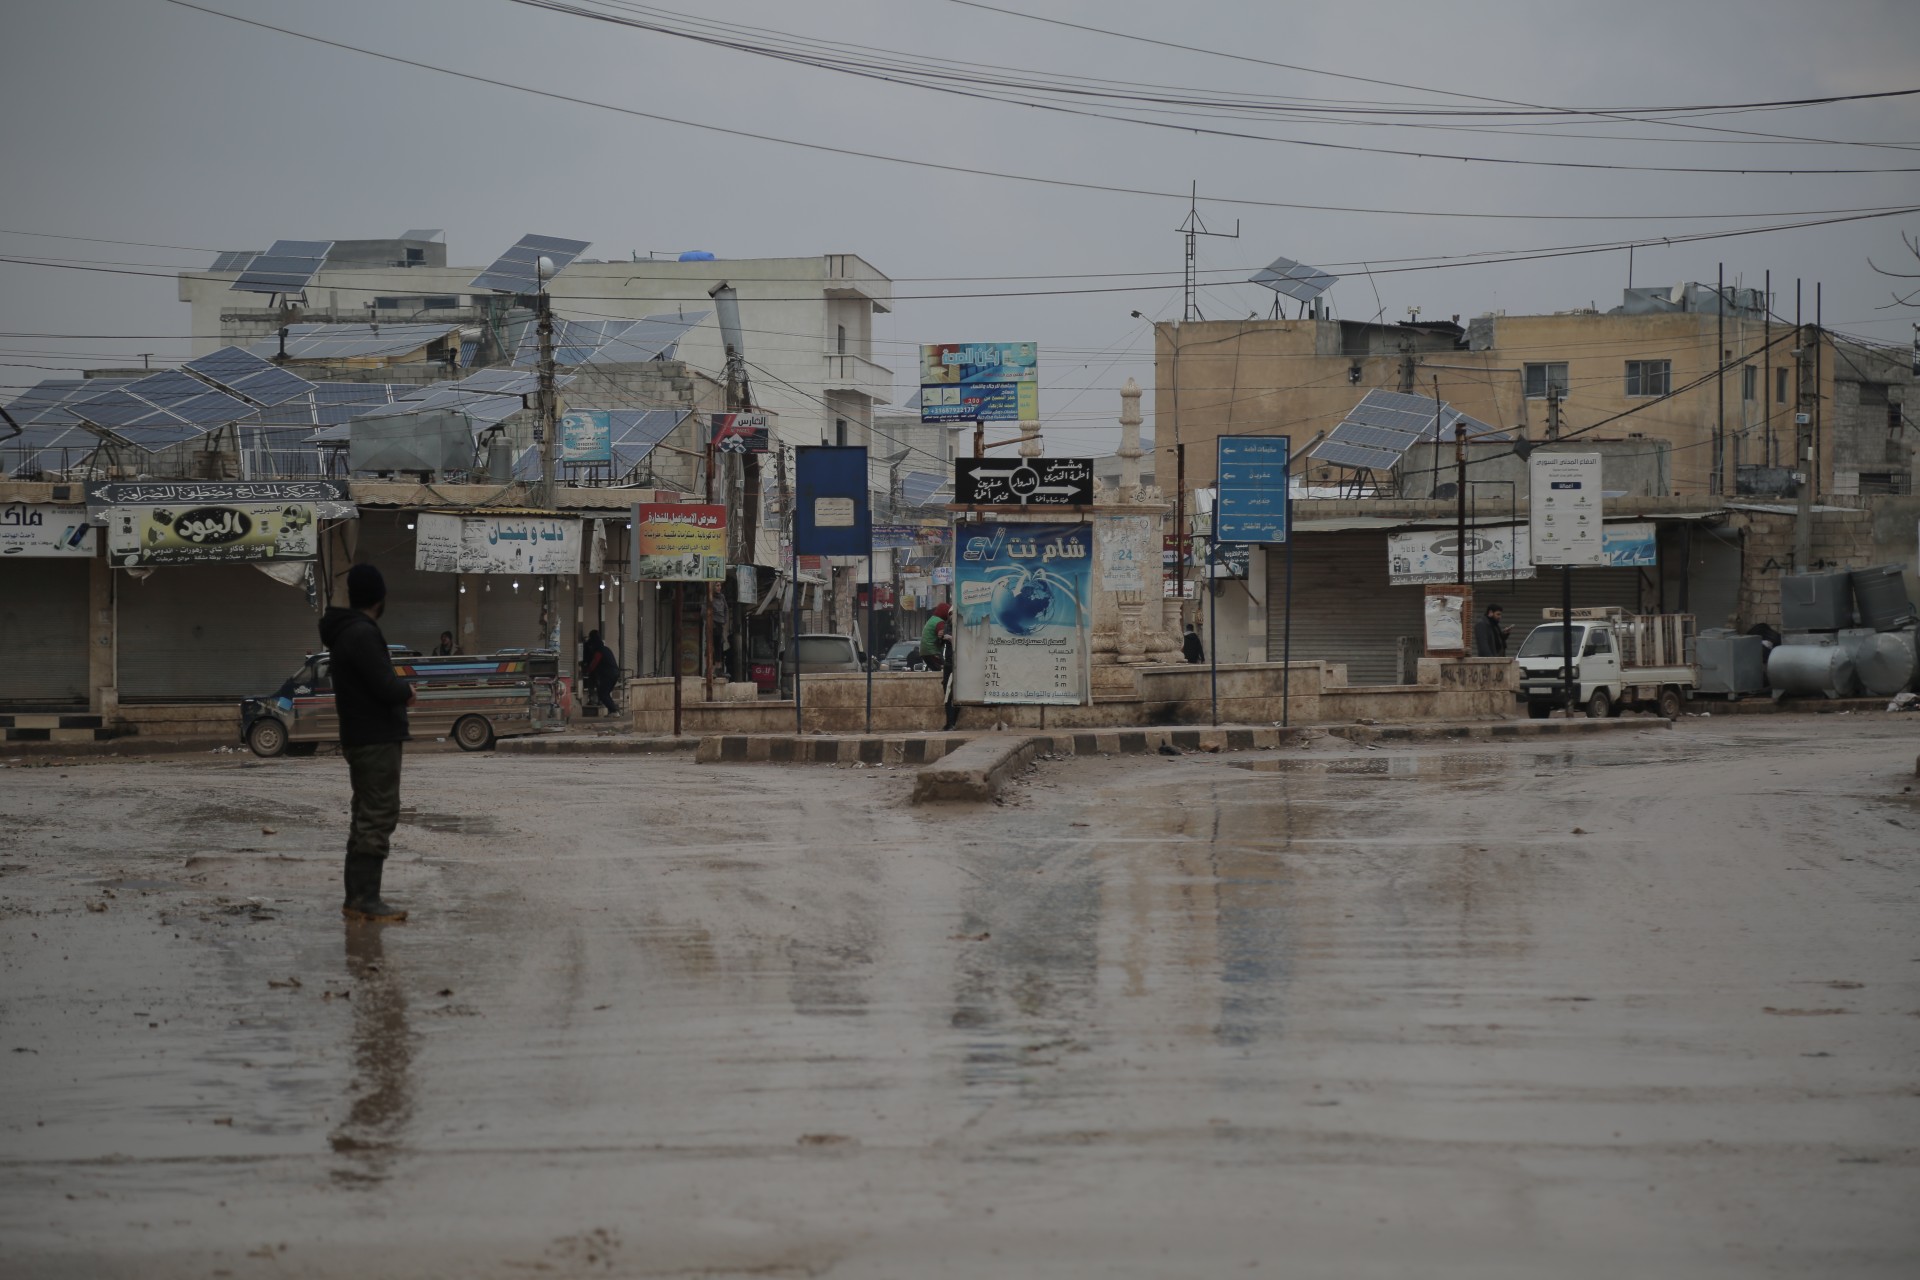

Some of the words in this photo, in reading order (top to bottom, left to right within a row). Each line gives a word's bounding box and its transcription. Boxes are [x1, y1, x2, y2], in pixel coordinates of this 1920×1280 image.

[942, 348, 975, 366] الصحة
[975, 347, 1000, 367] ركن
[1047, 459, 1082, 472] مشفى
[1044, 470, 1068, 482] الخيري
[1069, 468, 1089, 481] أطمة
[977, 479, 1003, 489] عفرين
[1012, 477, 1035, 488] الدوار
[117, 485, 176, 502] للصرافة
[178, 486, 234, 501] مصطفى
[235, 484, 280, 499] الحاج
[282, 485, 321, 499] شركة
[973, 488, 991, 500] أطمة
[992, 491, 1009, 504] مخيم
[697, 512, 718, 525] معرض
[179, 511, 243, 543] الجود
[540, 521, 564, 541] دلة
[1006, 537, 1037, 559] نت
[1042, 536, 1086, 563] شام
[1118, 549, 1132, 560] 24
[1047, 637, 1067, 646] أسعار
